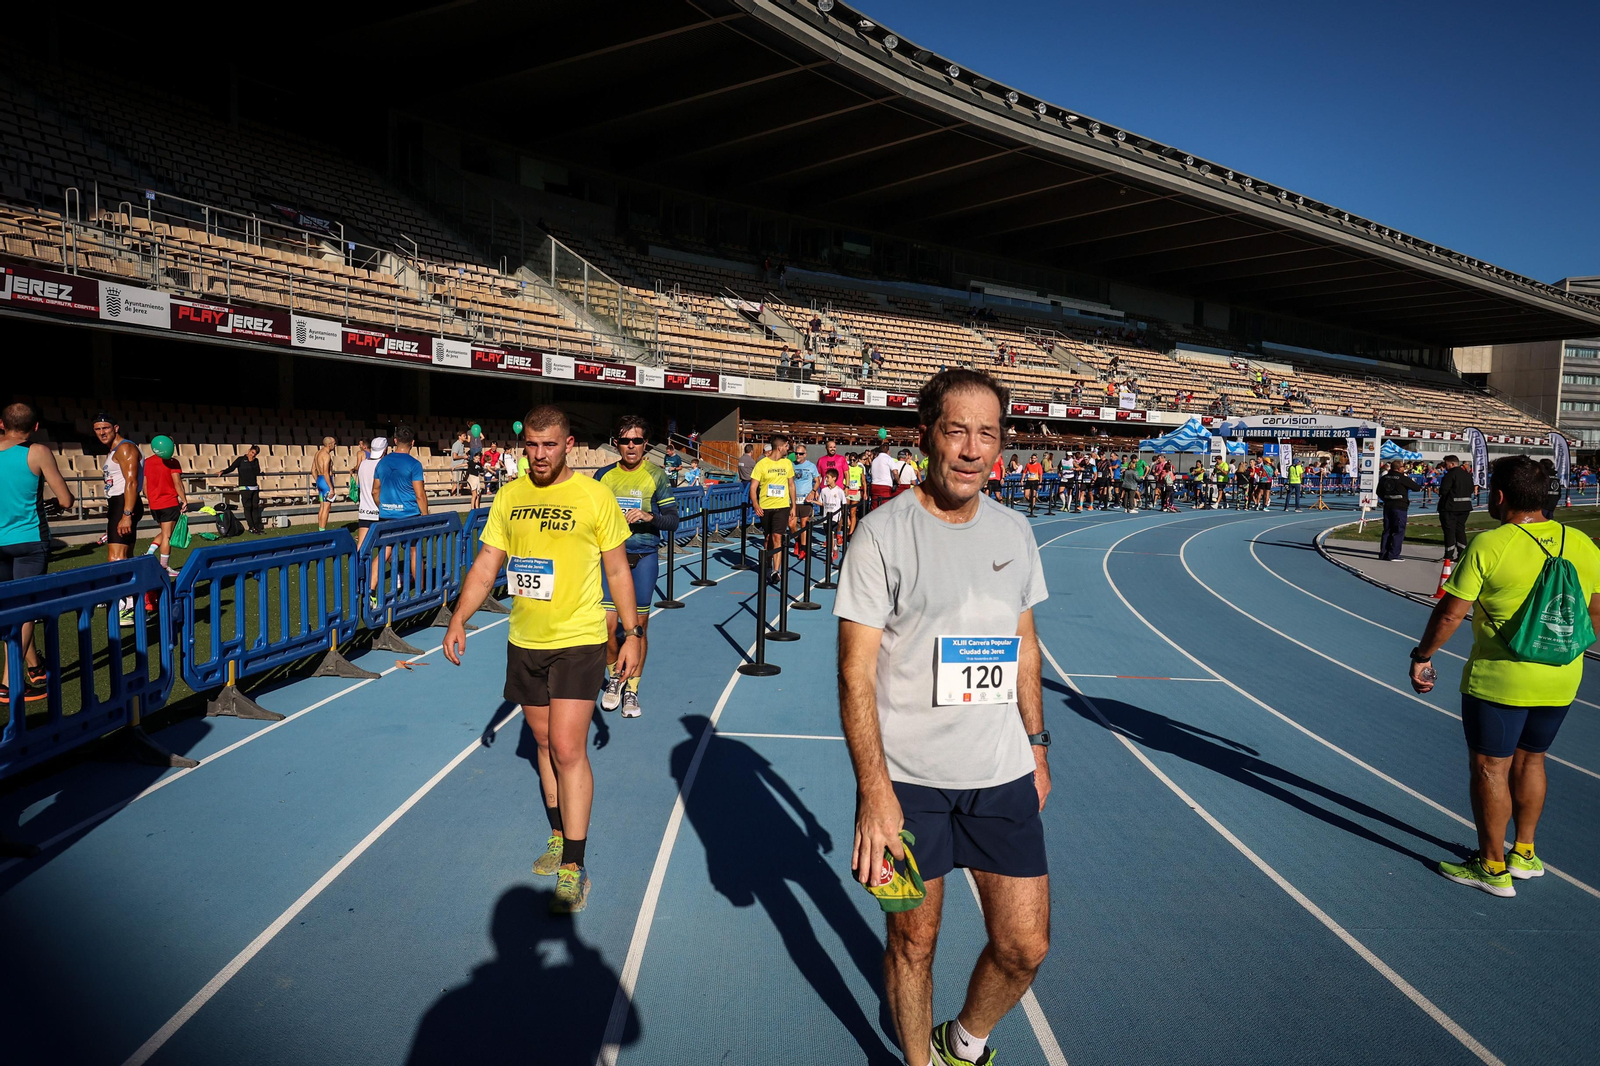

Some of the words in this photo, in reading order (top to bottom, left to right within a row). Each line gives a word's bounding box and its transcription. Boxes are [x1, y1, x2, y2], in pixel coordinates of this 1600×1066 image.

[0, 268, 73, 301] JEREZ
[124, 299, 164, 310] Ayuntamiento
[133, 307, 148, 315] Jerez
[178, 306, 225, 324] PLAY
[216, 308, 273, 334] JEREZ
[309, 328, 338, 337] Ayuntamiento
[347, 333, 382, 347] PLAY
[375, 334, 419, 355] JEREZ
[475, 351, 502, 363] PLAY
[497, 352, 532, 369] JEREZ
[578, 365, 601, 375] PLAY
[596, 364, 627, 380] JEREZ
[667, 375, 688, 384] PLAY
[683, 374, 711, 389] JEREZ
[835, 390, 859, 401] JEREZ
[1262, 415, 1317, 425] carvision
[510, 508, 573, 520] FITNESS
[516, 573, 541, 590] 835
[990, 639, 1012, 647] Popular
[961, 665, 1003, 689] 120
